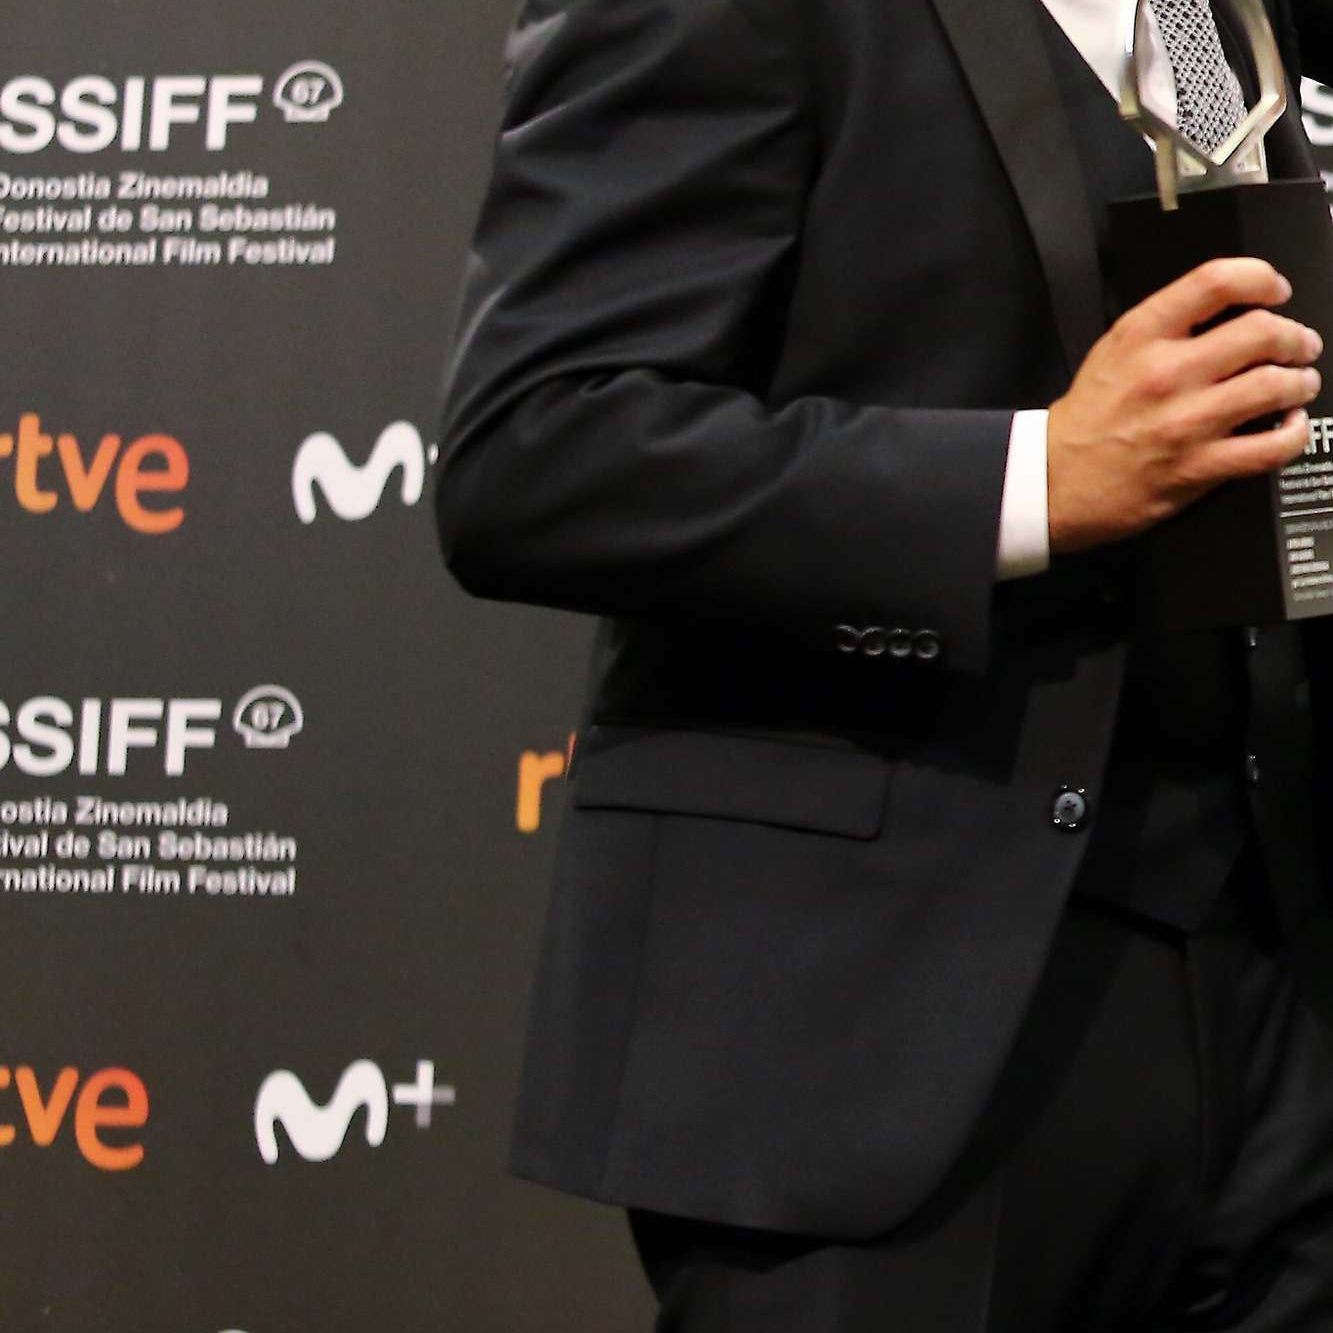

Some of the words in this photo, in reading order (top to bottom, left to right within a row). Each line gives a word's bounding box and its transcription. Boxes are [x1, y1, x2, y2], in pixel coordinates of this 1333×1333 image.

[0, 75, 264, 154] SSIFF
[117, 169, 270, 199] Zinemaldia
[97, 205, 133, 232] de
[139, 203, 192, 232] San
[163, 236, 221, 265] Film
[228, 235, 335, 265] Festival
[0, 412, 189, 535] tve
[0, 695, 222, 777] SIFF
[0, 796, 67, 825] ostia
[75, 795, 228, 827] Zinemaldia
[54, 830, 91, 859] de
[97, 829, 151, 860] San
[121, 864, 181, 894] Film
[188, 864, 296, 895] Festival
[0, 1066, 149, 1170] ve
